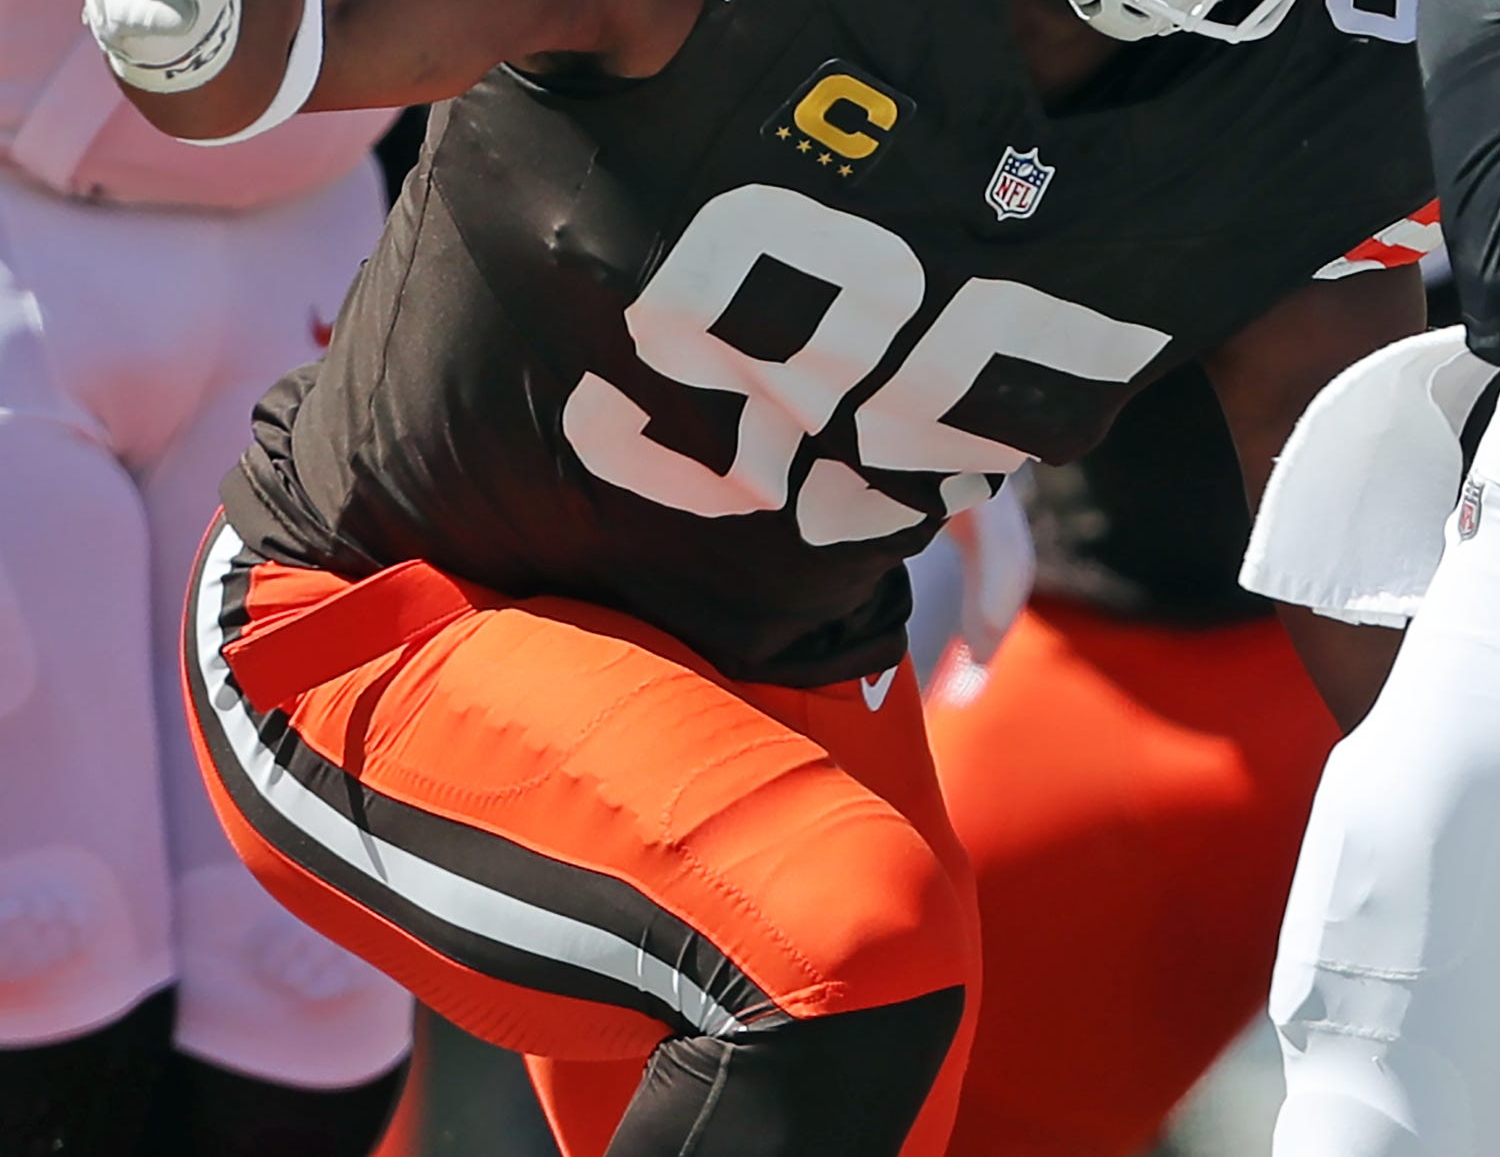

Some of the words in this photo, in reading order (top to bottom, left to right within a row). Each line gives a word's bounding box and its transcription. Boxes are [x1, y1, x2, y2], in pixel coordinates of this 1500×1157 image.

[794, 73, 898, 160] C
[995, 175, 1031, 209] NFL
[562, 183, 1173, 547] 95
